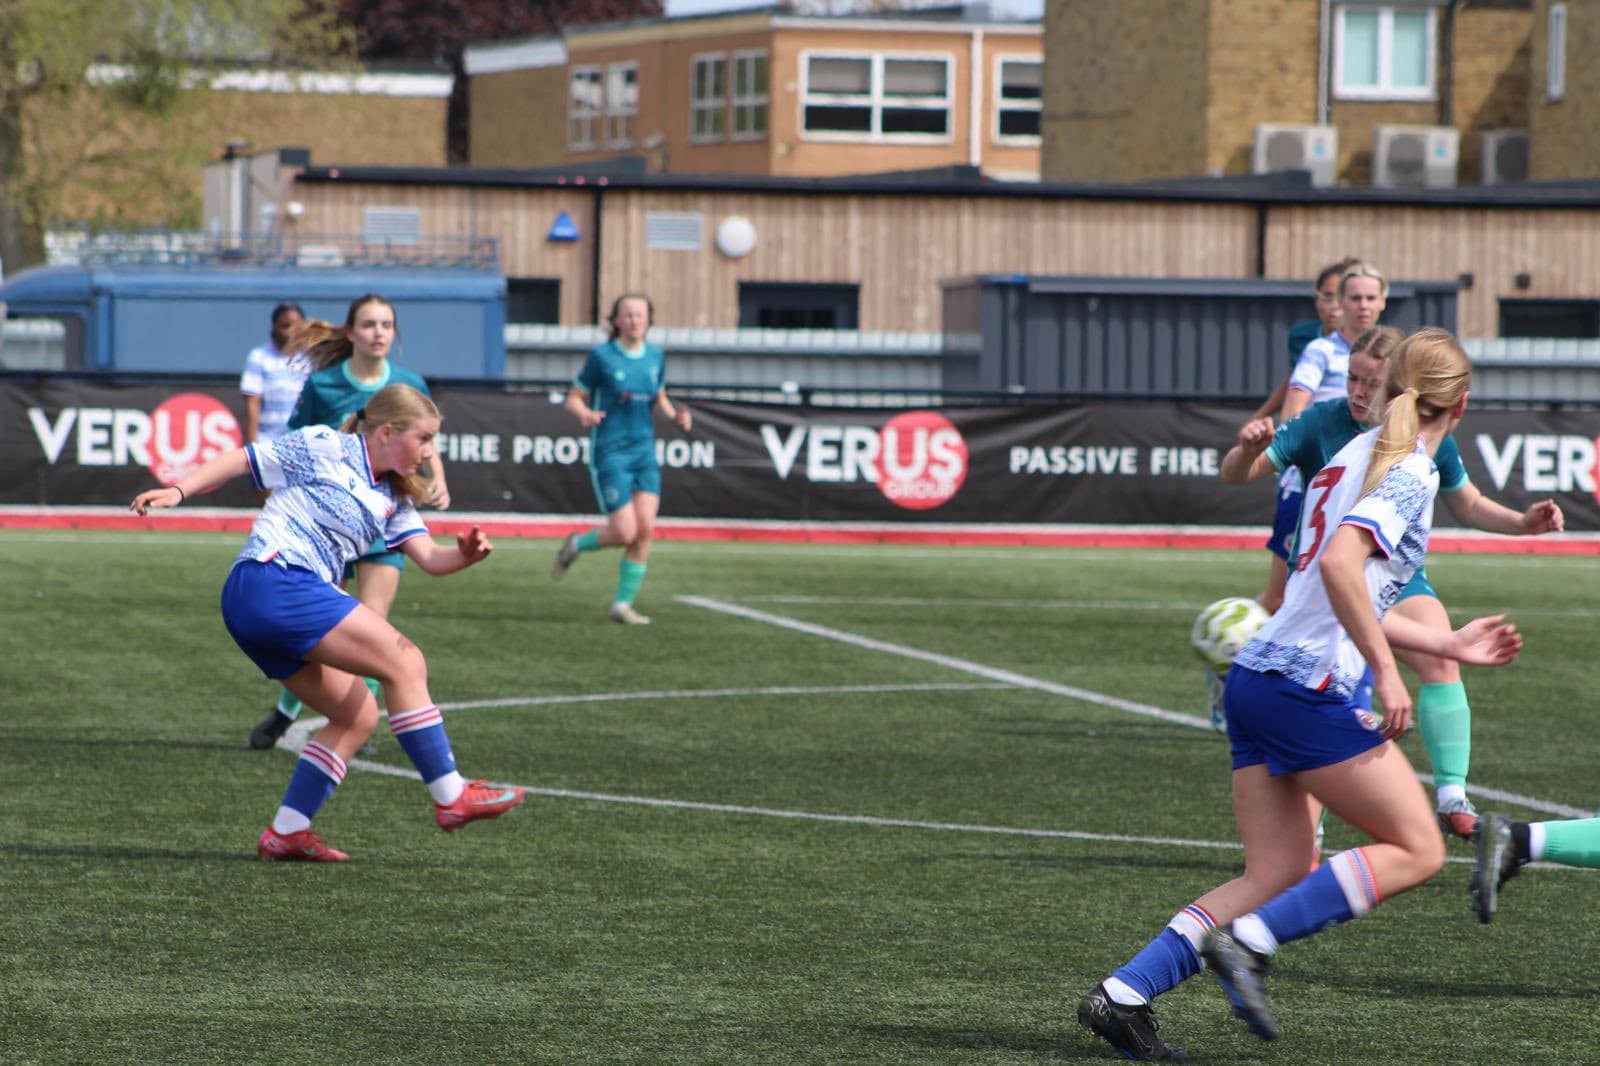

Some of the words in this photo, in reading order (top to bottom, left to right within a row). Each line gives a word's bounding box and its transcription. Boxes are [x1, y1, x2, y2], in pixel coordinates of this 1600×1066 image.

[28, 407, 238, 466] VERUS
[432, 433, 500, 463] FIRE
[513, 435, 715, 468] PROTION
[760, 424, 964, 482] VERUS
[1009, 446, 1137, 475] PASSIVE
[1151, 447, 1220, 477] FIRE
[1475, 434, 1599, 492] VER
[1295, 466, 1346, 572] 3
